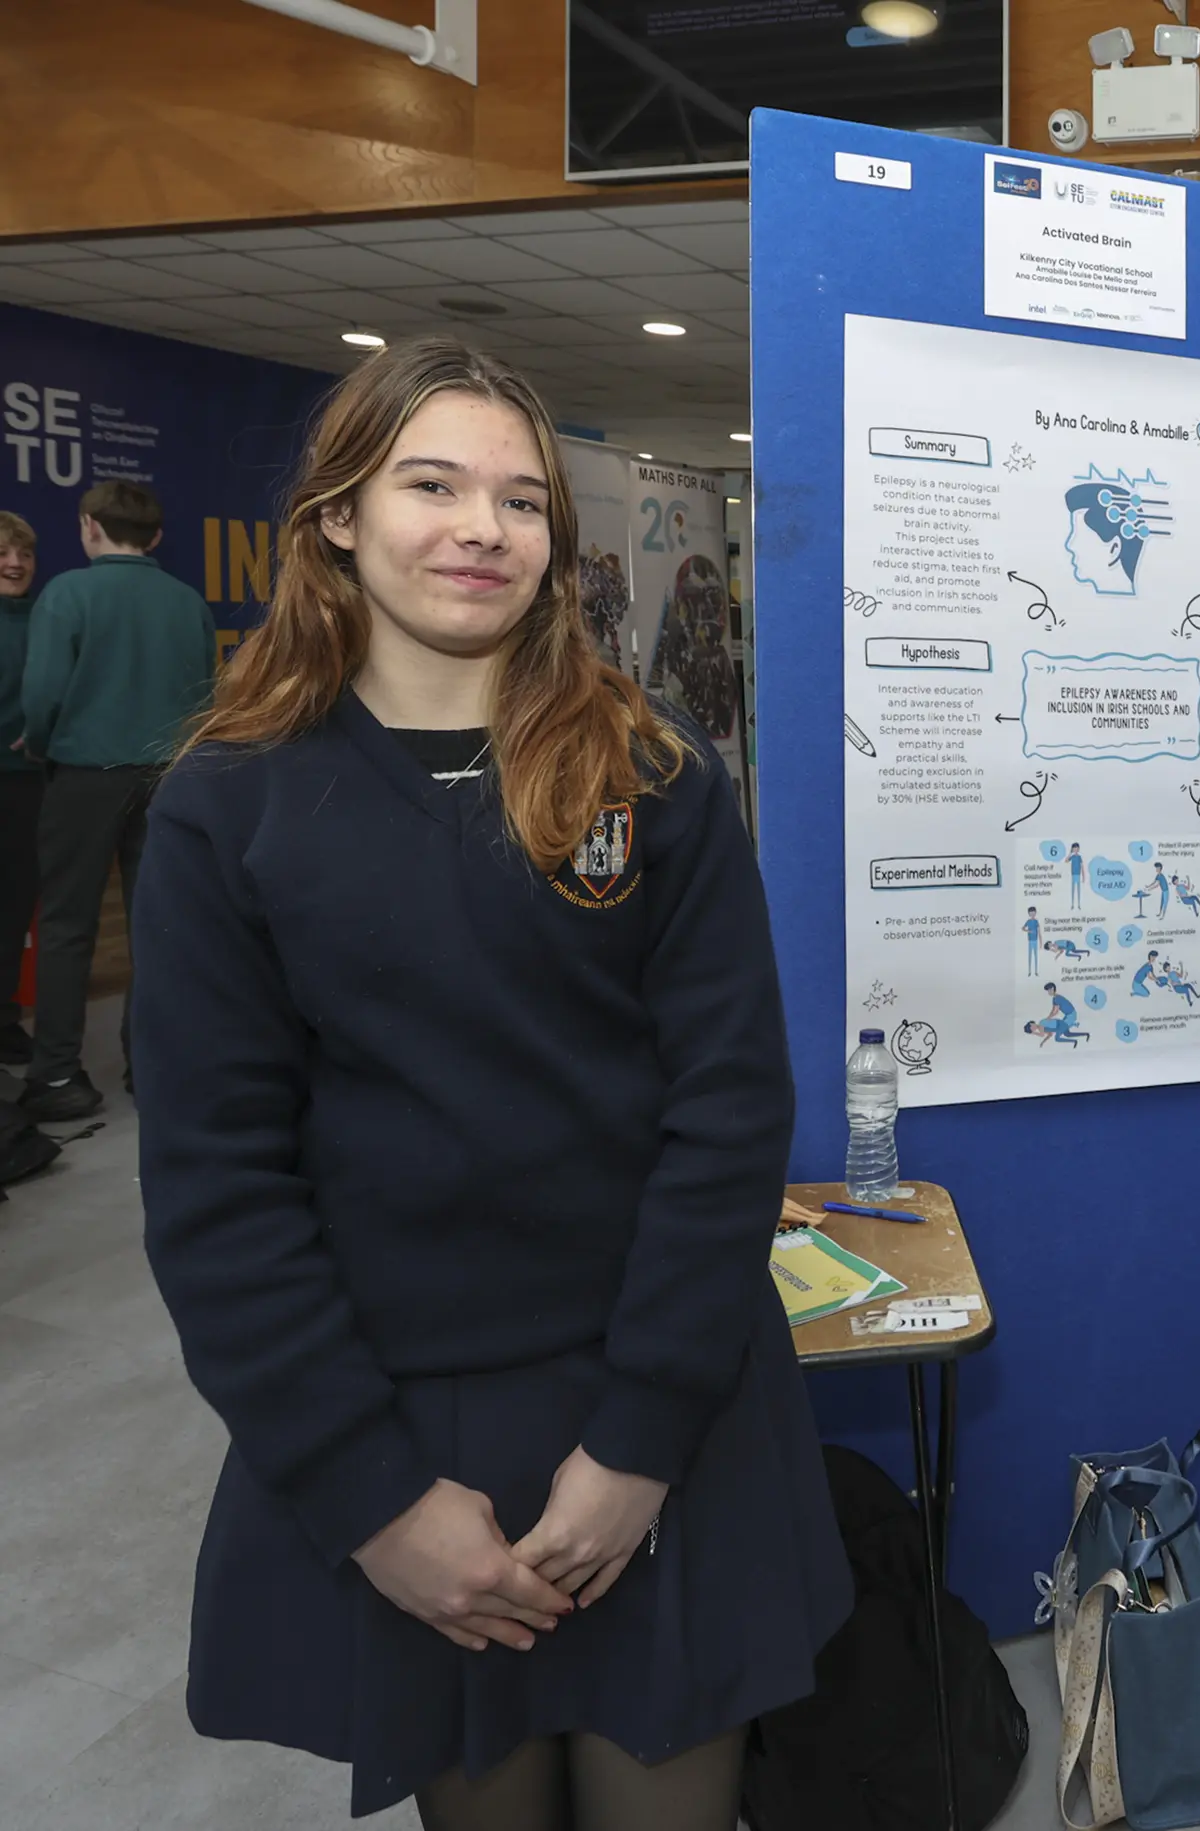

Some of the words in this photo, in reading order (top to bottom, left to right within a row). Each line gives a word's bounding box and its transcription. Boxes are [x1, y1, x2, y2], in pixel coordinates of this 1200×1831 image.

[868, 164, 886, 180] 19
[1070, 183, 1084, 194] SE
[1071, 194, 1085, 204] TU
[1110, 190, 1166, 210] CALMAST
[1042, 226, 1099, 244] Activated
[1101, 235, 1131, 249] Brain
[1019, 253, 1057, 267] Kilkenny
[1058, 258, 1076, 269] City
[1077, 261, 1123, 274] Vocational
[1124, 267, 1153, 278] School
[1035, 265, 1068, 276] Amabille
[1069, 270, 1092, 279] Louise
[1103, 275, 1123, 284] Mello
[1123, 278, 1138, 286] and
[1015, 272, 1030, 280] Ana
[1031, 274, 1063, 284] Carolina
[1063, 278, 1077, 286] Dos
[1078, 280, 1103, 290] Santos
[1130, 287, 1157, 297] Ferreira
[1028, 304, 1046, 314] intel
[3, 382, 82, 438] SE
[1035, 409, 1050, 429] By
[1053, 412, 1077, 429] Ana
[1080, 414, 1126, 434] Carolina
[1129, 420, 1139, 435] &
[1143, 422, 1189, 441] Amabille
[904, 434, 956, 457] Summary
[4, 433, 82, 487] TU
[639, 467, 675, 486] MATHS
[678, 474, 698, 490] FOR
[700, 478, 717, 494] ALL
[873, 475, 916, 488] Epilepsy
[919, 479, 927, 488] is
[929, 480, 935, 488] a
[938, 481, 1000, 494] neurological
[882, 490, 931, 501] condition
[934, 493, 955, 503] that
[957, 496, 991, 506] causes
[873, 503, 915, 514] seizures
[917, 506, 937, 516] due
[939, 508, 950, 517] to
[952, 509, 1000, 520] abnormal
[904, 519, 930, 528] brain
[895, 531, 916, 542] This
[918, 534, 954, 545] project
[957, 538, 979, 546] uses
[880, 544, 935, 557] interactive
[936, 549, 981, 560] activities
[983, 552, 994, 560] to
[872, 559, 909, 569] reduce
[951, 564, 979, 573] teach
[982, 564, 1000, 575] first
[915, 575, 934, 584] and
[937, 577, 980, 587] promote
[876, 587, 922, 597] inclusion
[937, 590, 959, 599] Irish
[961, 592, 998, 602] schools
[891, 603, 912, 611] and
[901, 644, 960, 663] Hypothesis
[878, 684, 932, 694] Interactive
[933, 686, 983, 696] education
[1060, 687, 1100, 699] EPILEPSY
[1104, 688, 1157, 701] AWARENESS
[1160, 690, 1177, 701] AND
[887, 699, 907, 707] and
[910, 699, 962, 709] awareness
[963, 699, 974, 709] of
[1047, 701, 1093, 714] INCLUSION
[1095, 703, 1104, 714] IN
[1107, 702, 1129, 714] IRISH
[1131, 703, 1170, 715] SCHOOLS
[1173, 704, 1190, 716] AND
[880, 713, 925, 722] supports
[927, 713, 945, 722] like
[947, 713, 964, 722] the
[966, 713, 980, 722] LTI
[1091, 716, 1149, 730] COMMUNITIES
[879, 725, 920, 735] Scheme
[922, 727, 939, 735] will
[942, 727, 982, 736] increase
[898, 740, 943, 751] empathy
[945, 740, 964, 749] and
[878, 767, 924, 778] reducing
[926, 767, 972, 776] exclusion
[974, 768, 984, 776] in
[880, 781, 931, 790] simulated
[933, 781, 981, 790] situations
[877, 795, 890, 805] by
[892, 794, 913, 803] 30%
[915, 793, 938, 804] (HSE
[1050, 846, 1058, 856] 6
[1139, 846, 1144, 856] 1
[874, 866, 946, 884] Experimental
[948, 863, 992, 878] Methods
[908, 916, 927, 925] and
[930, 913, 989, 925] post-activity
[883, 927, 991, 940] observation/questions
[1093, 934, 1101, 946] 5
[1125, 930, 1133, 942] 2
[1091, 993, 1098, 1004] 4
[1123, 1026, 1130, 1037] 3
